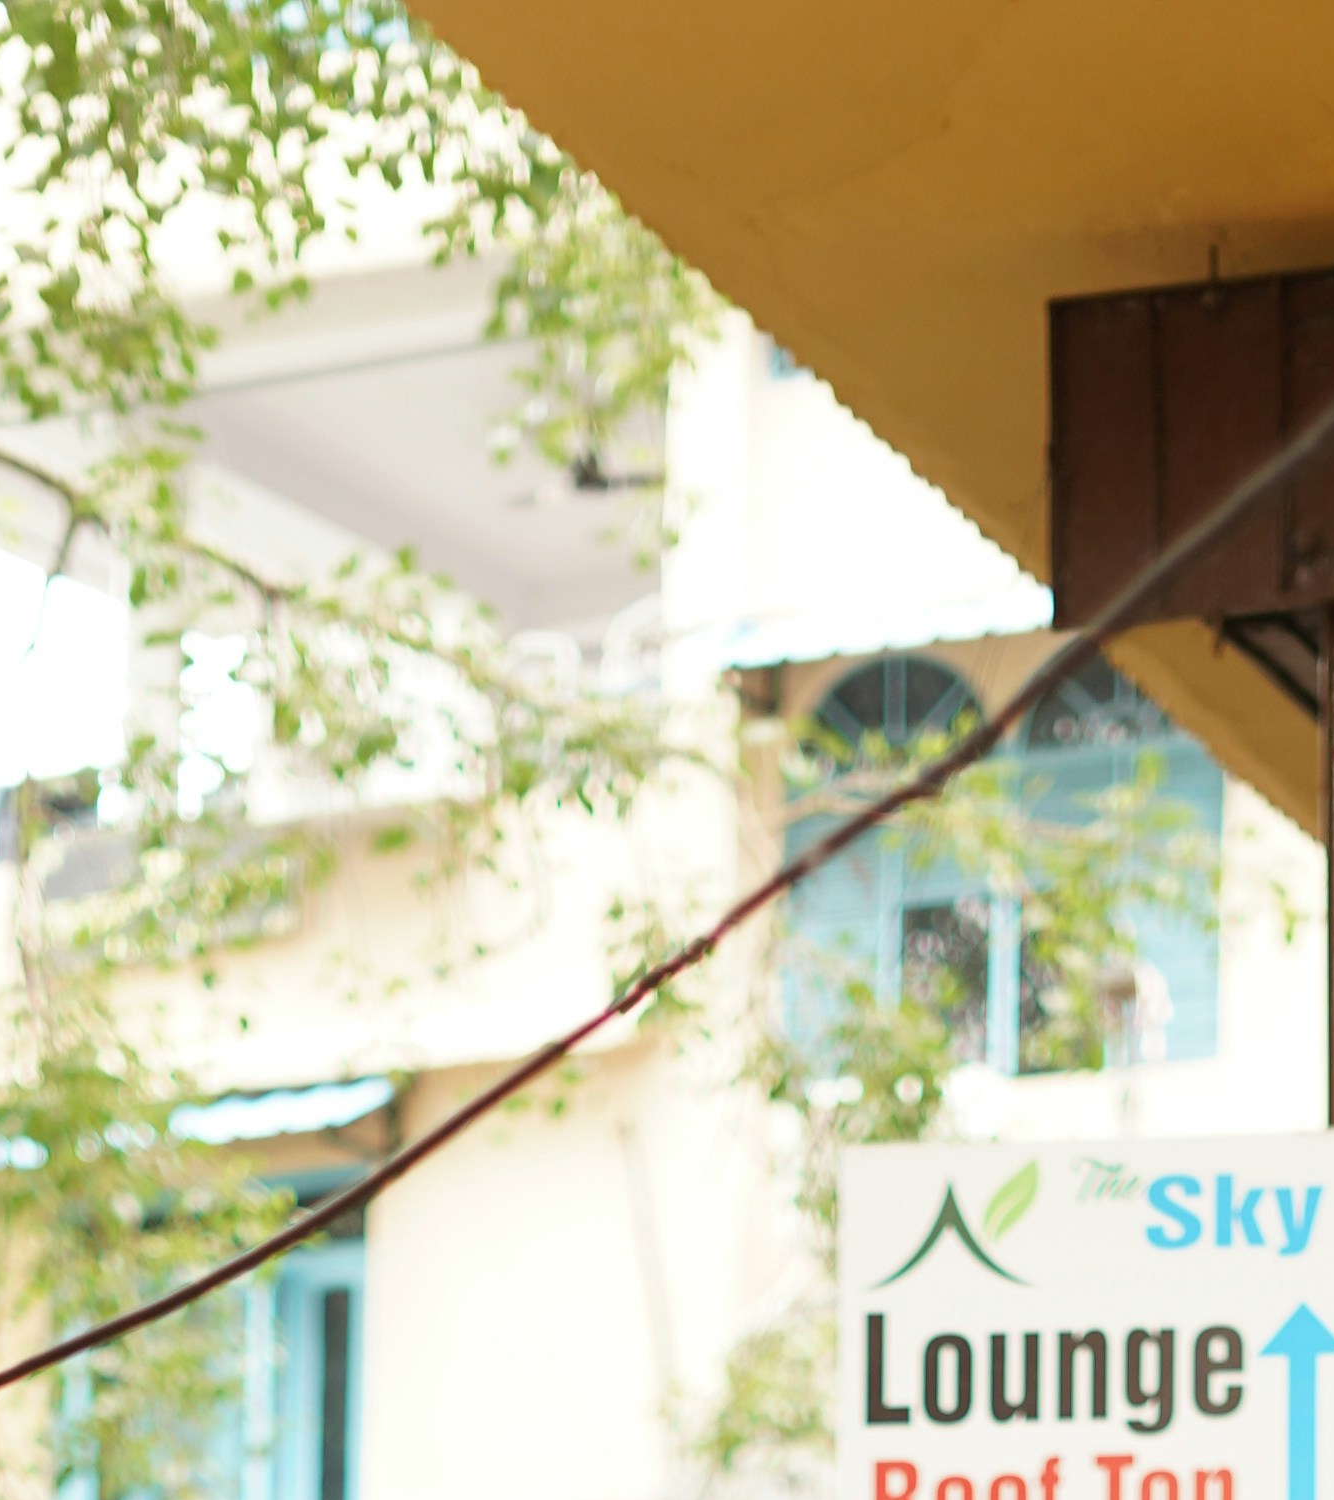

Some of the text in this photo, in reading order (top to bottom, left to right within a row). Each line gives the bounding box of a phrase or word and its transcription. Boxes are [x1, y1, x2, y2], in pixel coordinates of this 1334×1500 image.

[1071, 1156, 1323, 1257] The Sky
[865, 1312, 1244, 1431] Lounge
